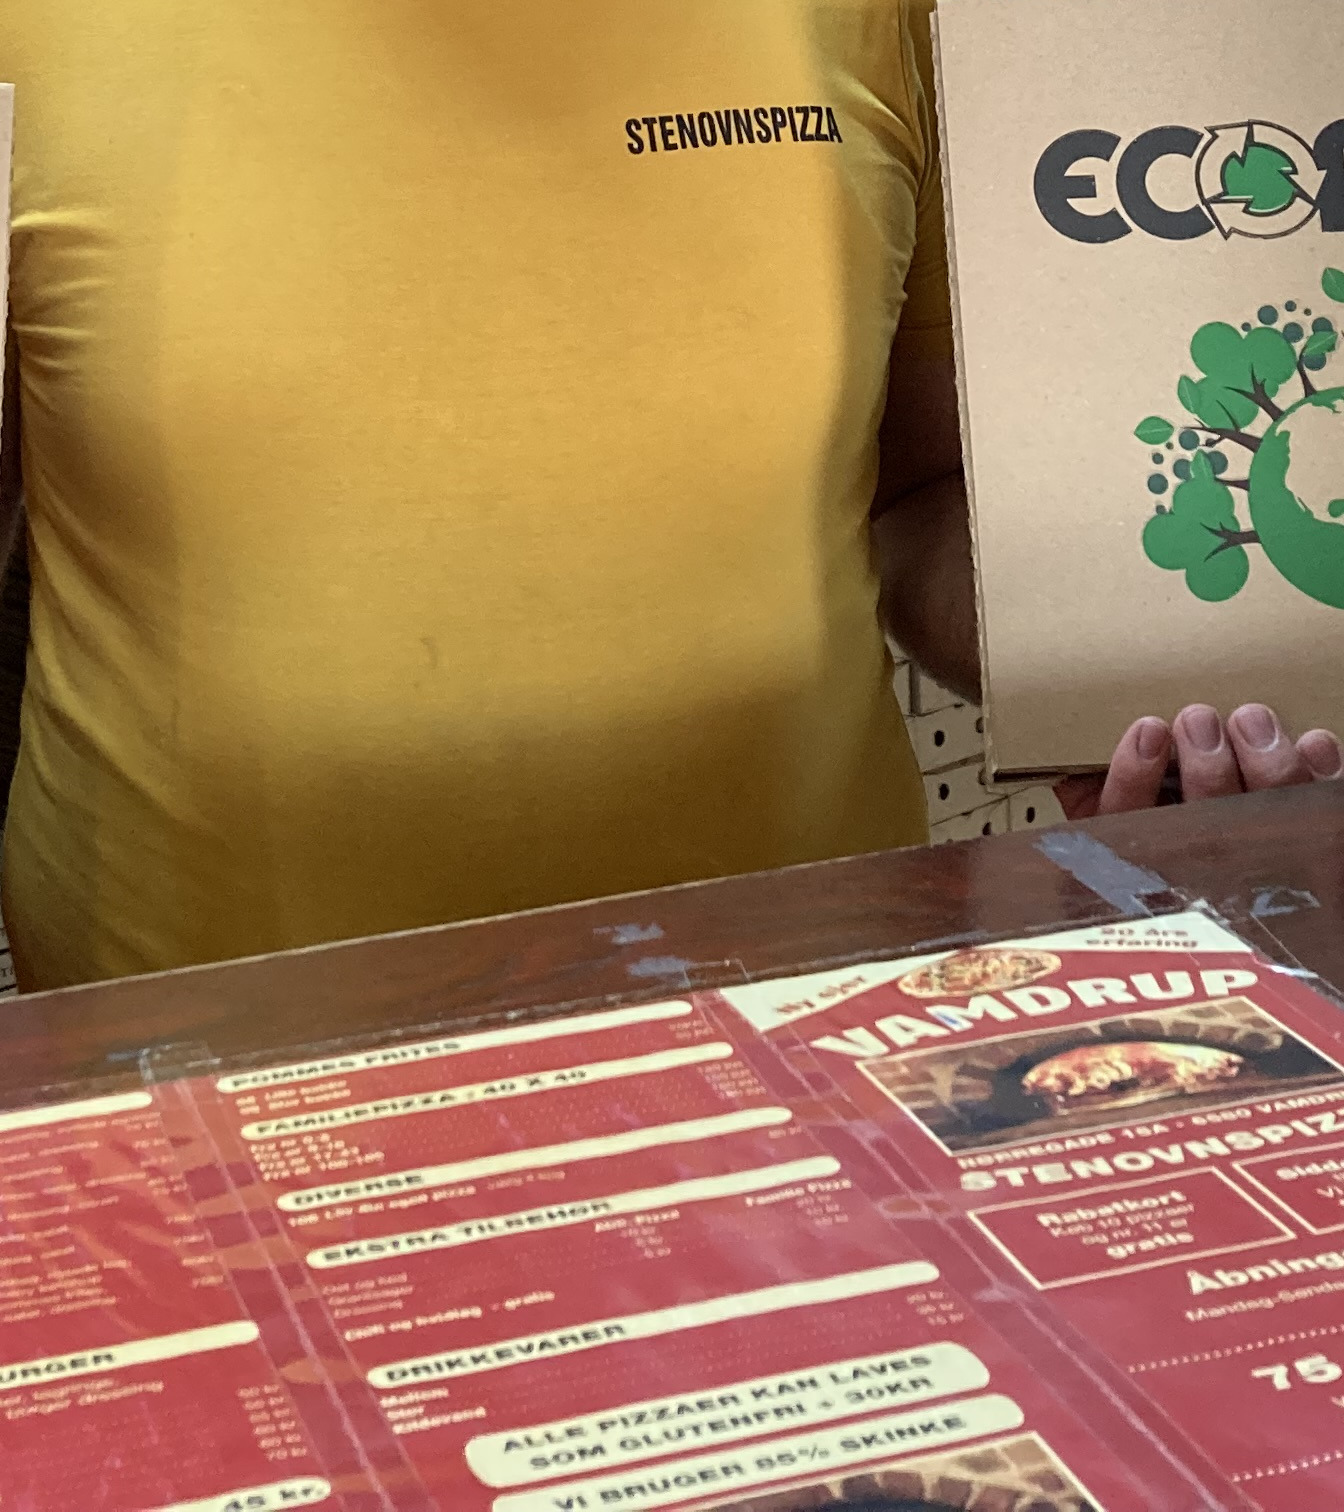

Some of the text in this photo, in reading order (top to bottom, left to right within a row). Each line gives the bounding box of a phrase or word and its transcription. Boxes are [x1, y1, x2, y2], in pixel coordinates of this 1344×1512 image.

[625, 106, 843, 155] STENOVNSPIZZA
[811, 969, 1259, 1059] VAMDRUP
[1036, 1189, 1187, 1228] Rabatkort
[386, 1324, 625, 1382] DRIKKEVARER
[1251, 1354, 1344, 1392] 75
[502, 1353, 934, 1454] ALLE PIZZAER KAN LAVES
[529, 1442, 607, 1470] SOM
[619, 1400, 808, 1452] GLUTENFRI
[553, 1414, 967, 1510] VI BRUGER SKINKE
